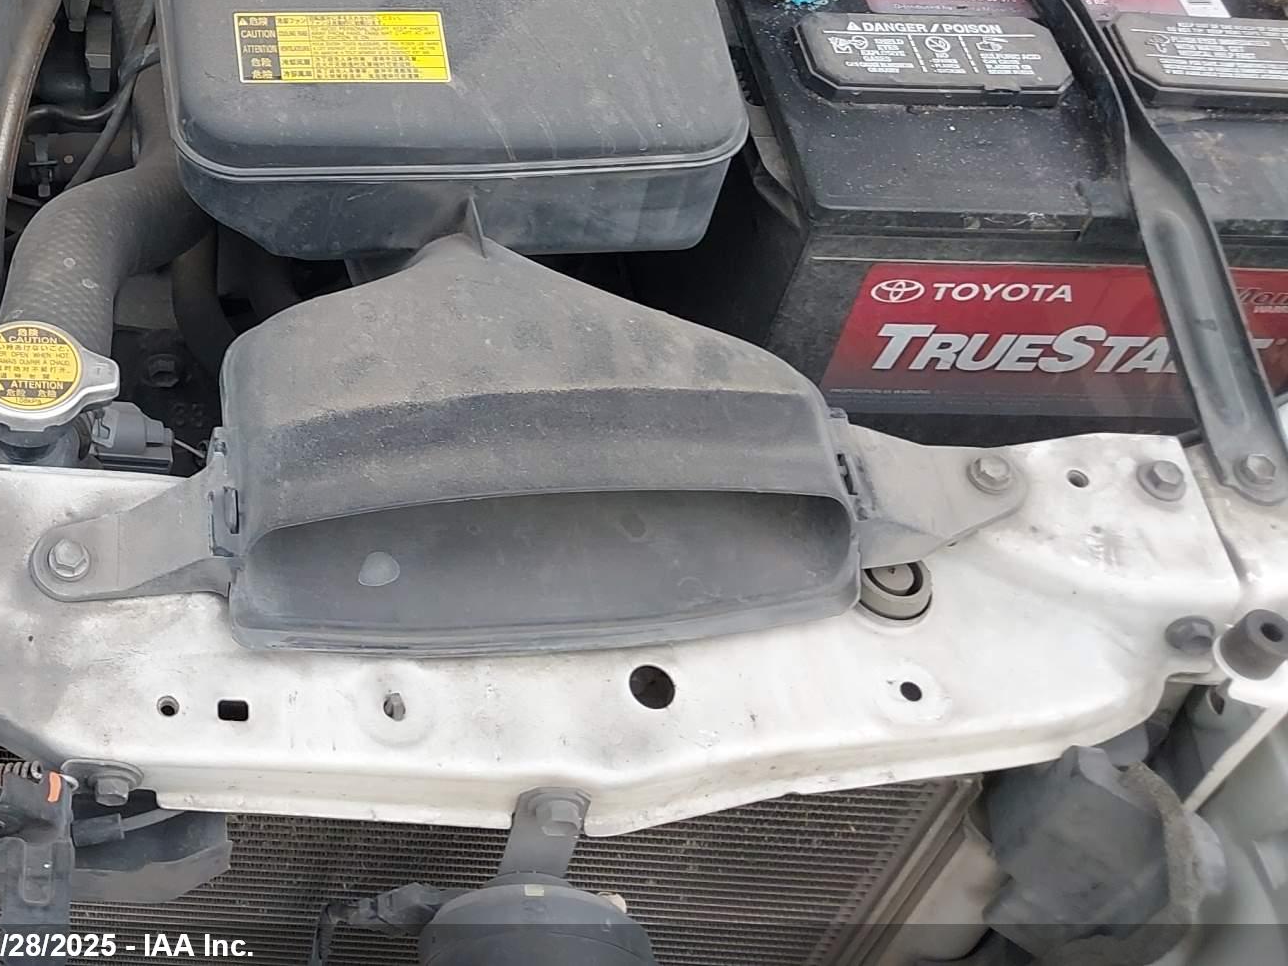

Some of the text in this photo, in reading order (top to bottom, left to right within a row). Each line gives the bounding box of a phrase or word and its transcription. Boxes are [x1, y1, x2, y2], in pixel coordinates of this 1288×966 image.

[862, 22, 928, 33] DANGER
[944, 23, 1003, 34] POISON
[240, 29, 276, 38] CAUTION
[242, 44, 278, 54] ATTENTION
[932, 282, 1074, 303] TOYOTA
[8, 336, 58, 344] CAUTION
[10, 381, 64, 390] ATTENTION
